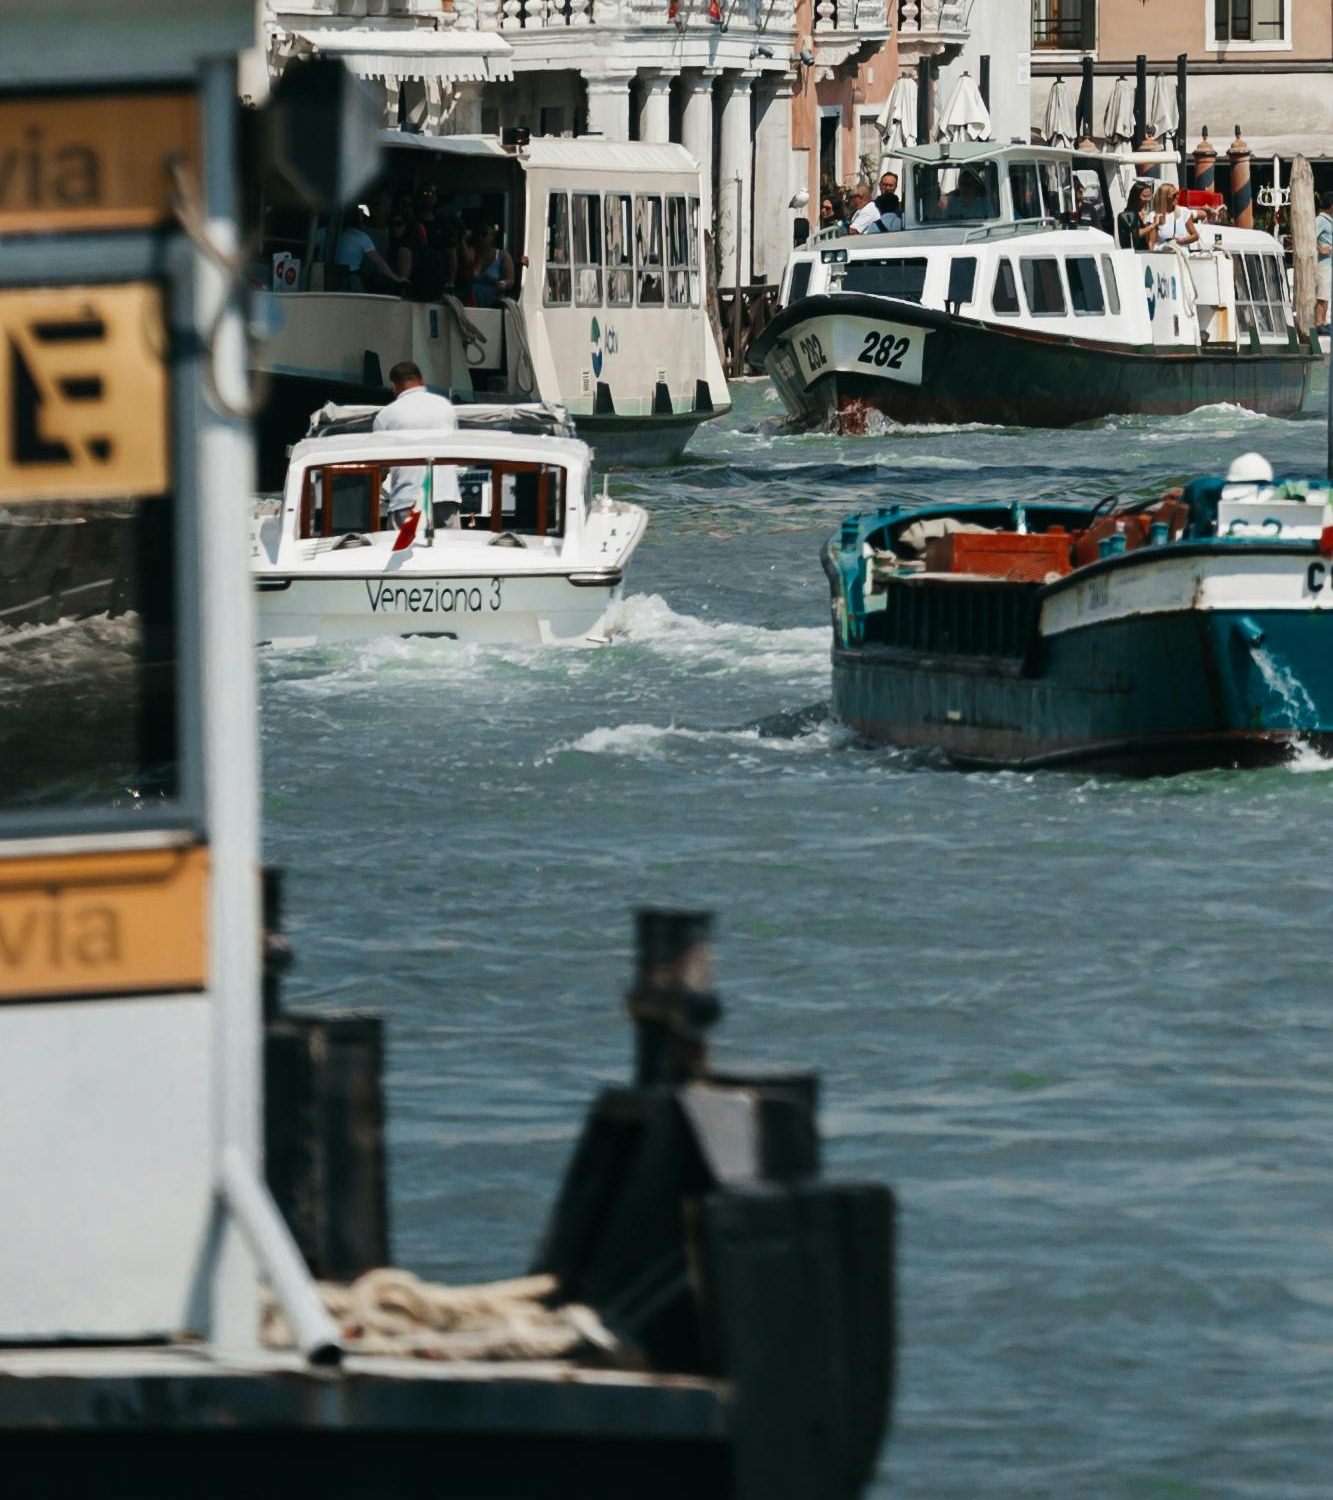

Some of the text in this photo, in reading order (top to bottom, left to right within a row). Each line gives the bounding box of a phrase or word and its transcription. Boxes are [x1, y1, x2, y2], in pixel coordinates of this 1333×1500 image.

[800, 333, 828, 372] 282
[857, 330, 911, 370] 282
[364, 579, 482, 613] Veneziana
